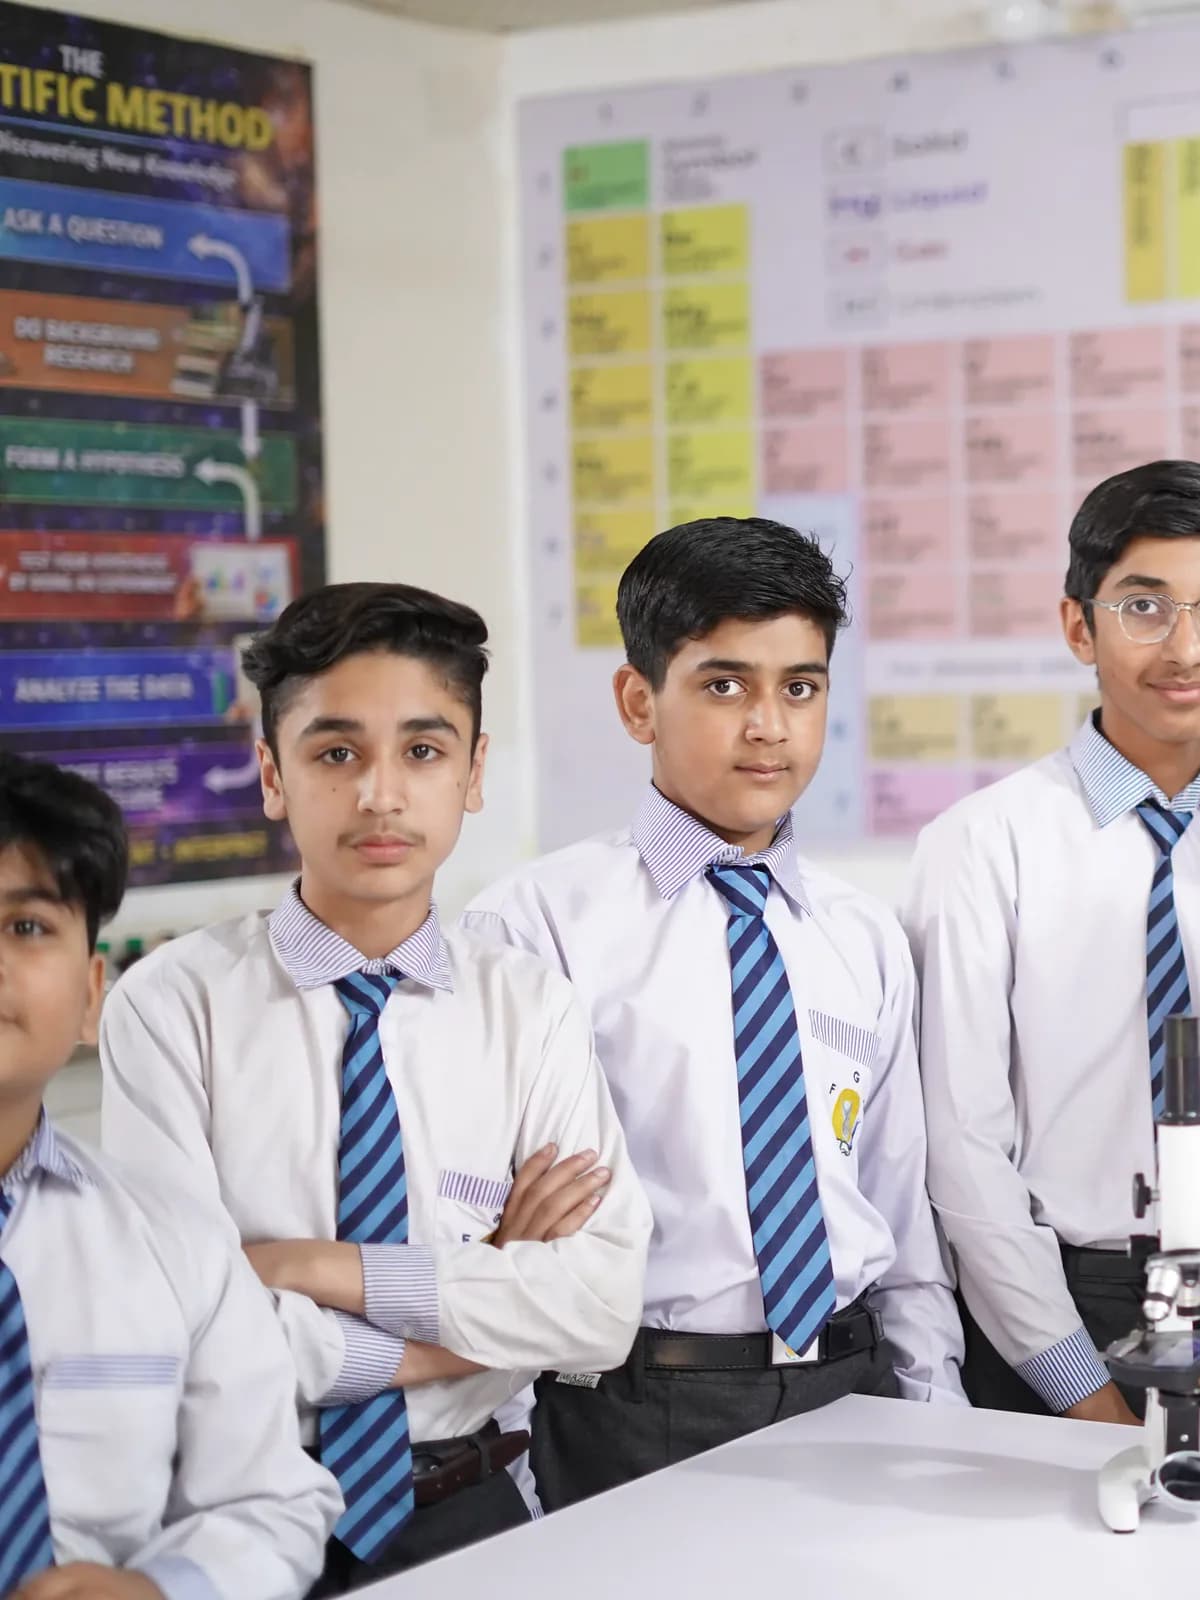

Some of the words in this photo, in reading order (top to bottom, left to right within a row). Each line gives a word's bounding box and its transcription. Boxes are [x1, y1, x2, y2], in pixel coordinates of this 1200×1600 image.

[59, 44, 105, 78] THE
[0, 66, 97, 122] TIFIC
[106, 84, 274, 151] METHOD
[4, 207, 43, 233] ASK
[48, 213, 62, 235] A
[67, 214, 164, 249] QUESTION
[5, 445, 60, 471] FORM
[64, 448, 77, 471] A
[15, 677, 101, 703] ANALYZE
[104, 675, 139, 700] THE
[829, 1083, 837, 1095] F
[853, 1071, 860, 1084] G
[462, 1234, 471, 1243] F
